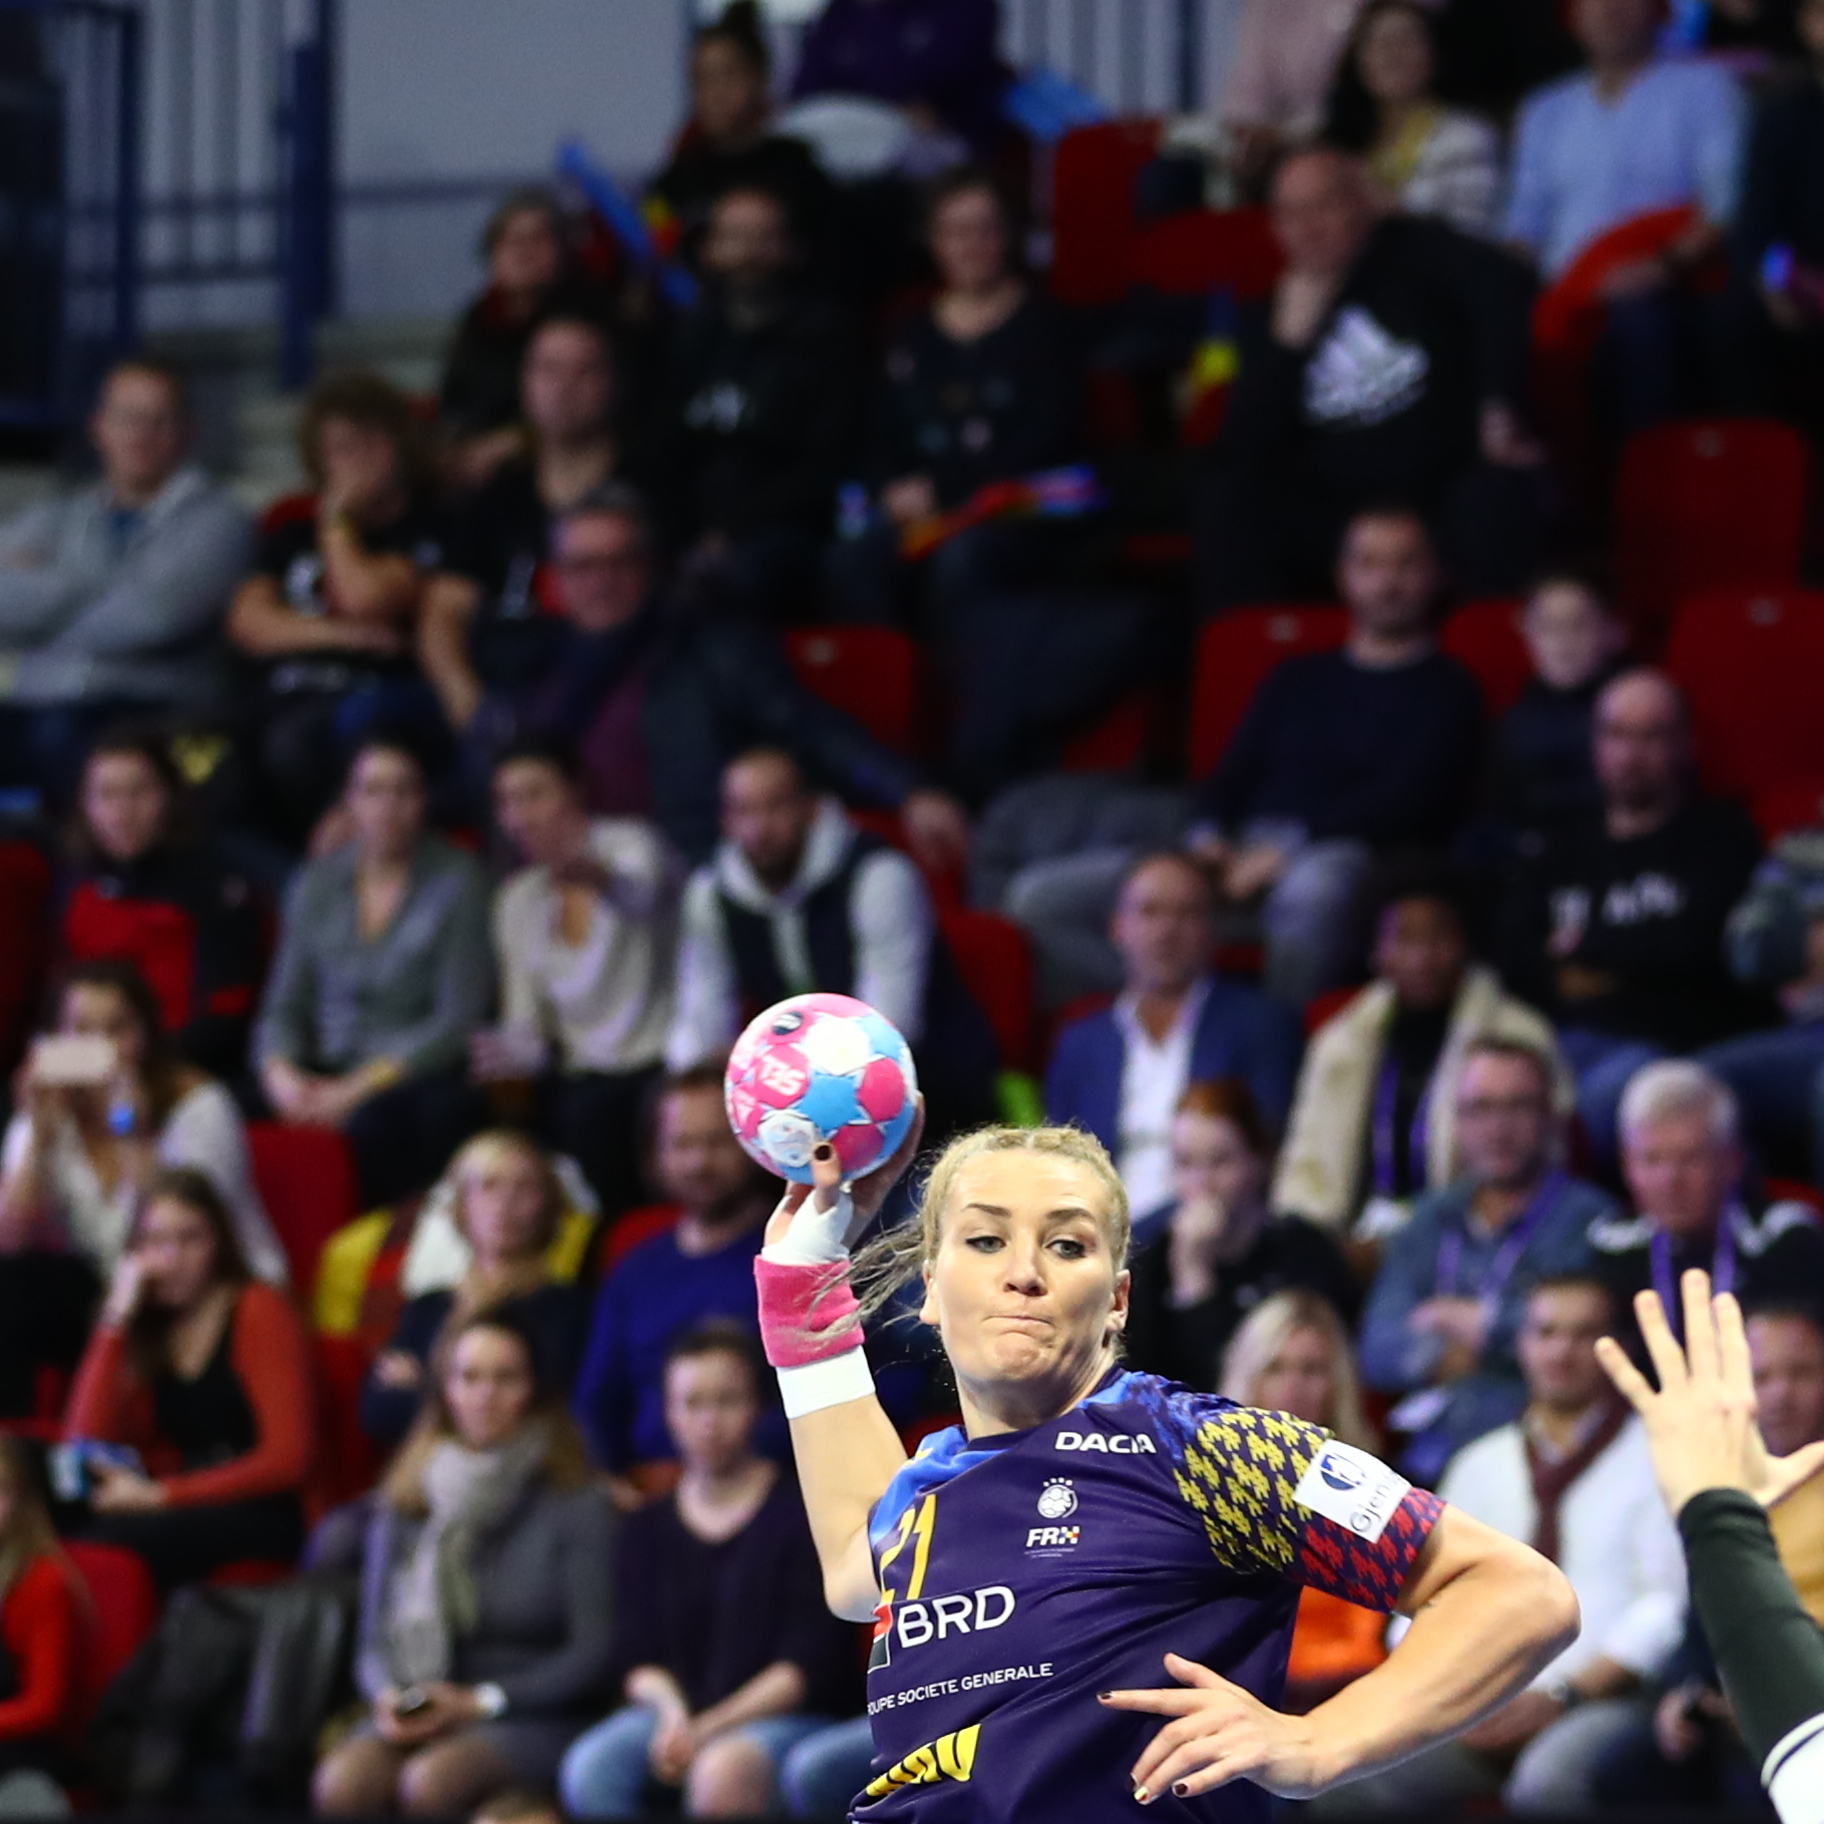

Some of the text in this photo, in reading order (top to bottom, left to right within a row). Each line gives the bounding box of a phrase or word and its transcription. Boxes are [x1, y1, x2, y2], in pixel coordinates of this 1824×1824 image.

[1054, 1431, 1157, 1454] DACIA
[896, 1585, 1016, 1649] BRD
[897, 1679, 959, 1707] SOCIETE
[961, 1663, 1054, 1691] GENERALE
